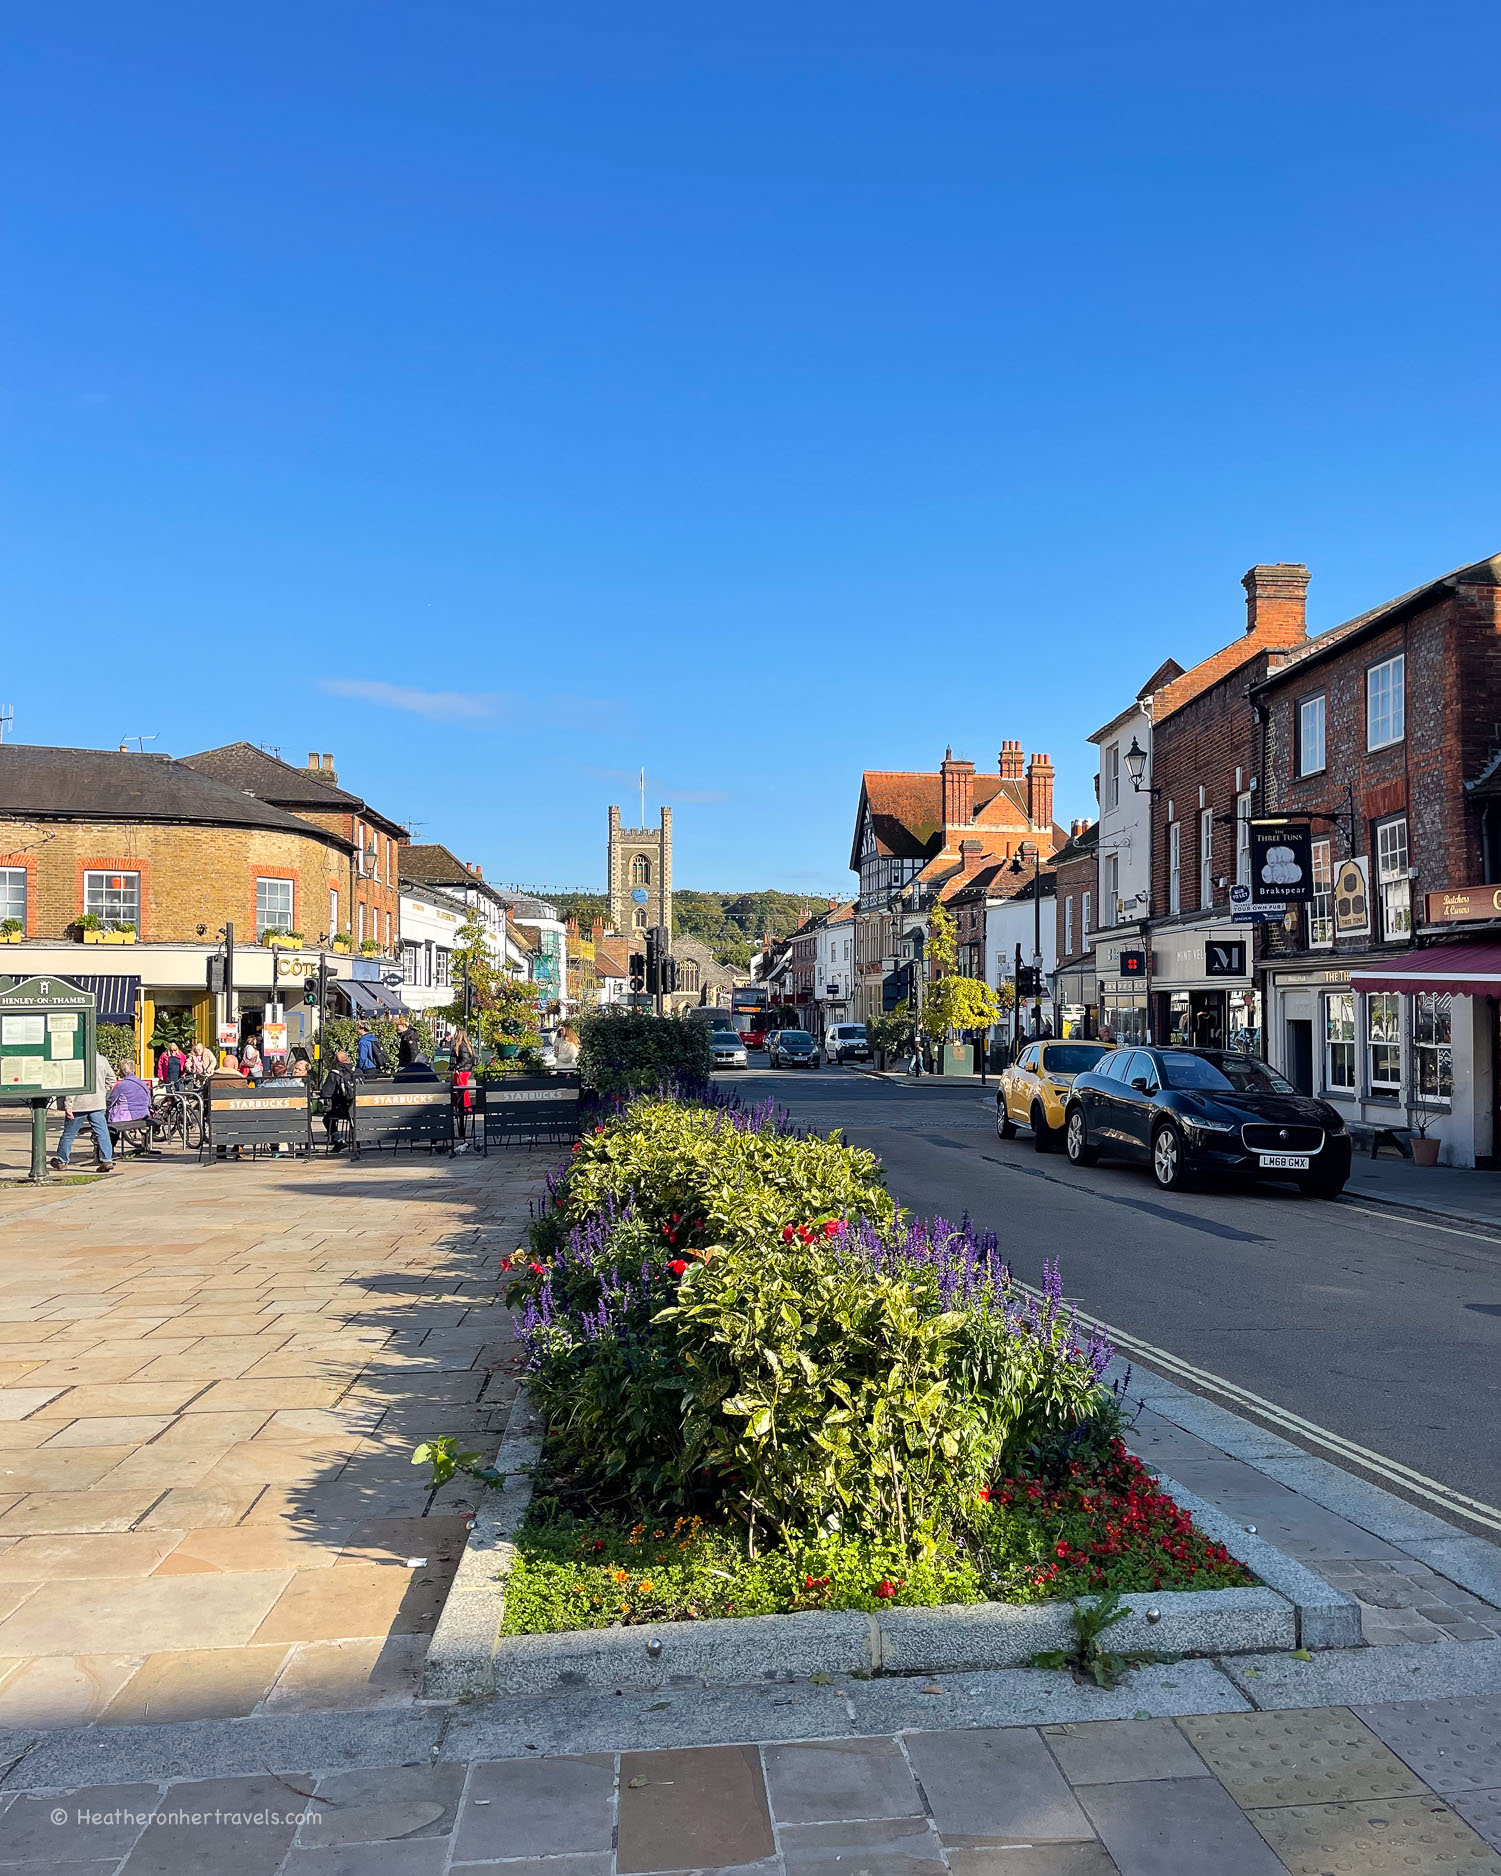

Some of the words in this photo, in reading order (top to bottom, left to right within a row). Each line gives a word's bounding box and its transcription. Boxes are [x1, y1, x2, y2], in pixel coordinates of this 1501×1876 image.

[1256, 834, 1280, 842] THREE
[1282, 833, 1303, 841] TUNS
[1259, 887, 1306, 896] Brakspear
[1443, 894, 1470, 905] Butchers
[277, 958, 317, 977] CÔTE
[1324, 971, 1338, 982] THE
[2, 996, 86, 1005] HENLEY-ON-THAMES
[373, 1095, 434, 1105] STARBUCKS
[503, 1091, 563, 1101] STARBUCKS
[229, 1098, 291, 1109] STARBUCKS
[1263, 1156, 1286, 1166] LM68
